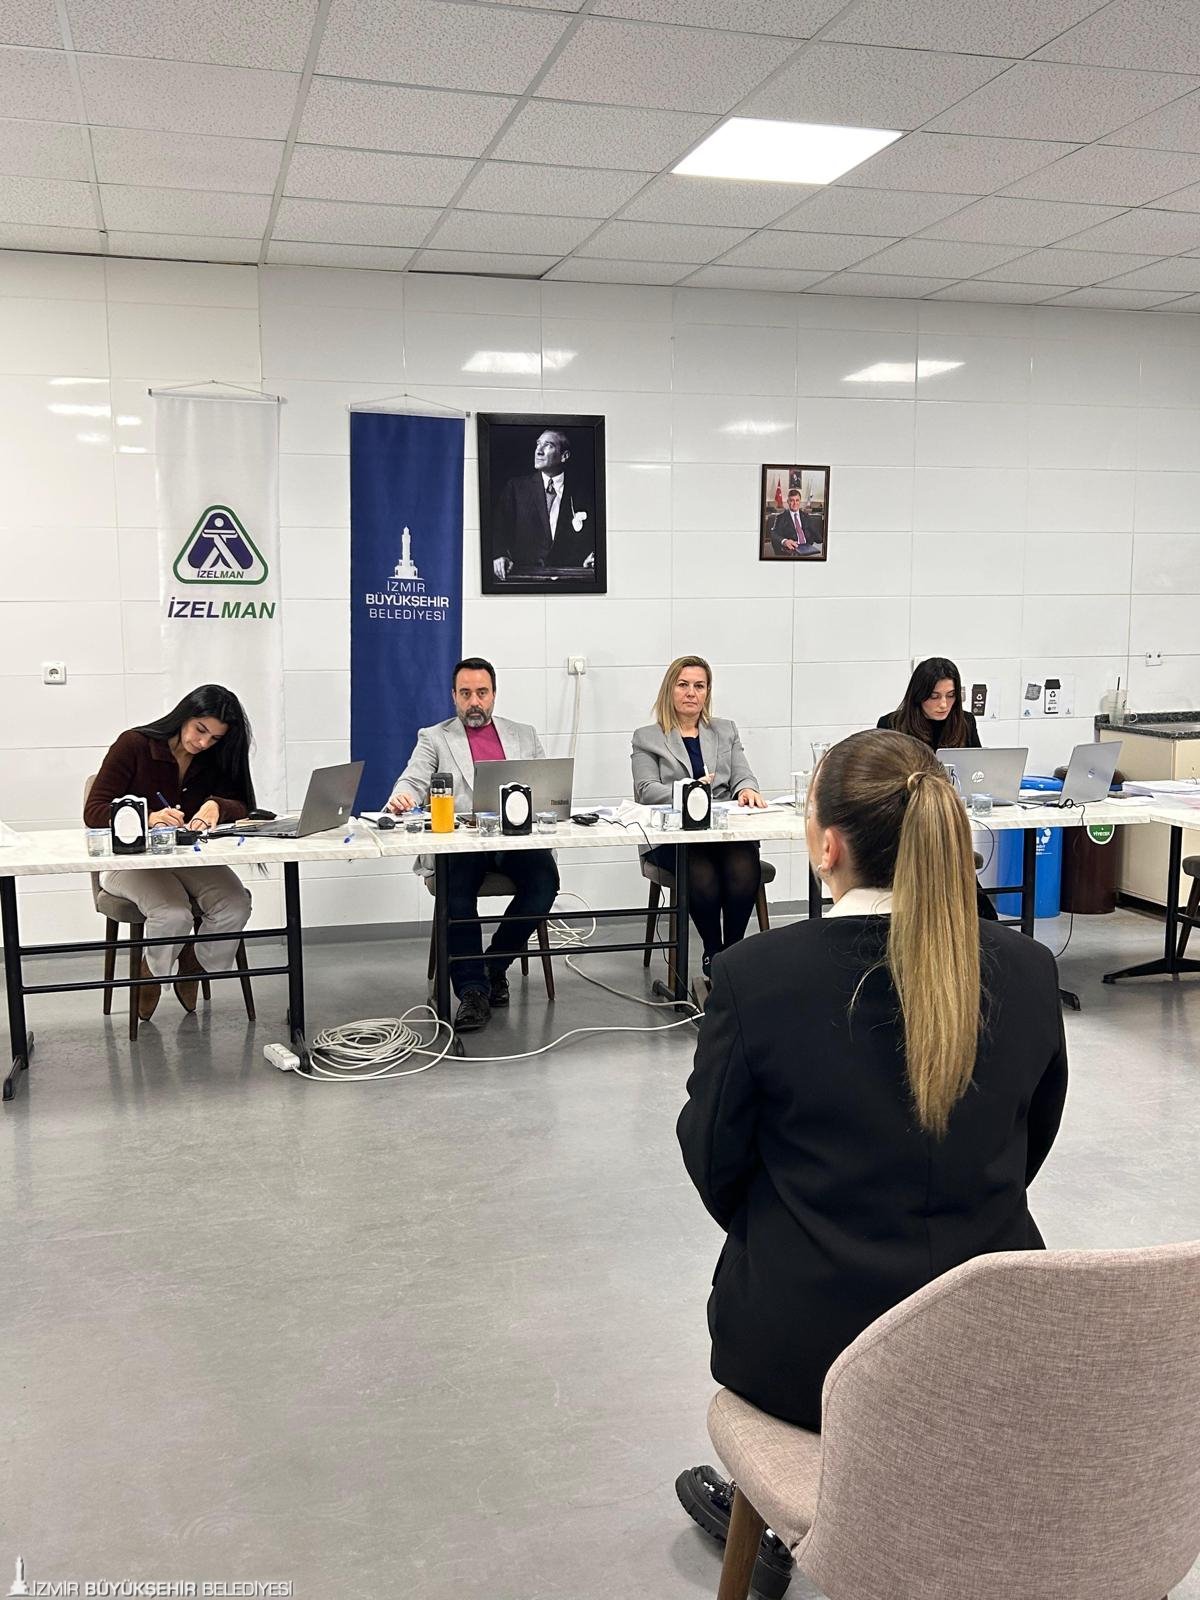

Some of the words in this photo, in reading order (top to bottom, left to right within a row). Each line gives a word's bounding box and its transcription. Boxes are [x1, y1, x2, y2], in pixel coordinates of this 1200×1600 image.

[167, 597, 276, 619] İZELMAN
[365, 592, 450, 608] BÜYÜKŞEHİR
[369, 608, 446, 621] BELEDİYESİ
